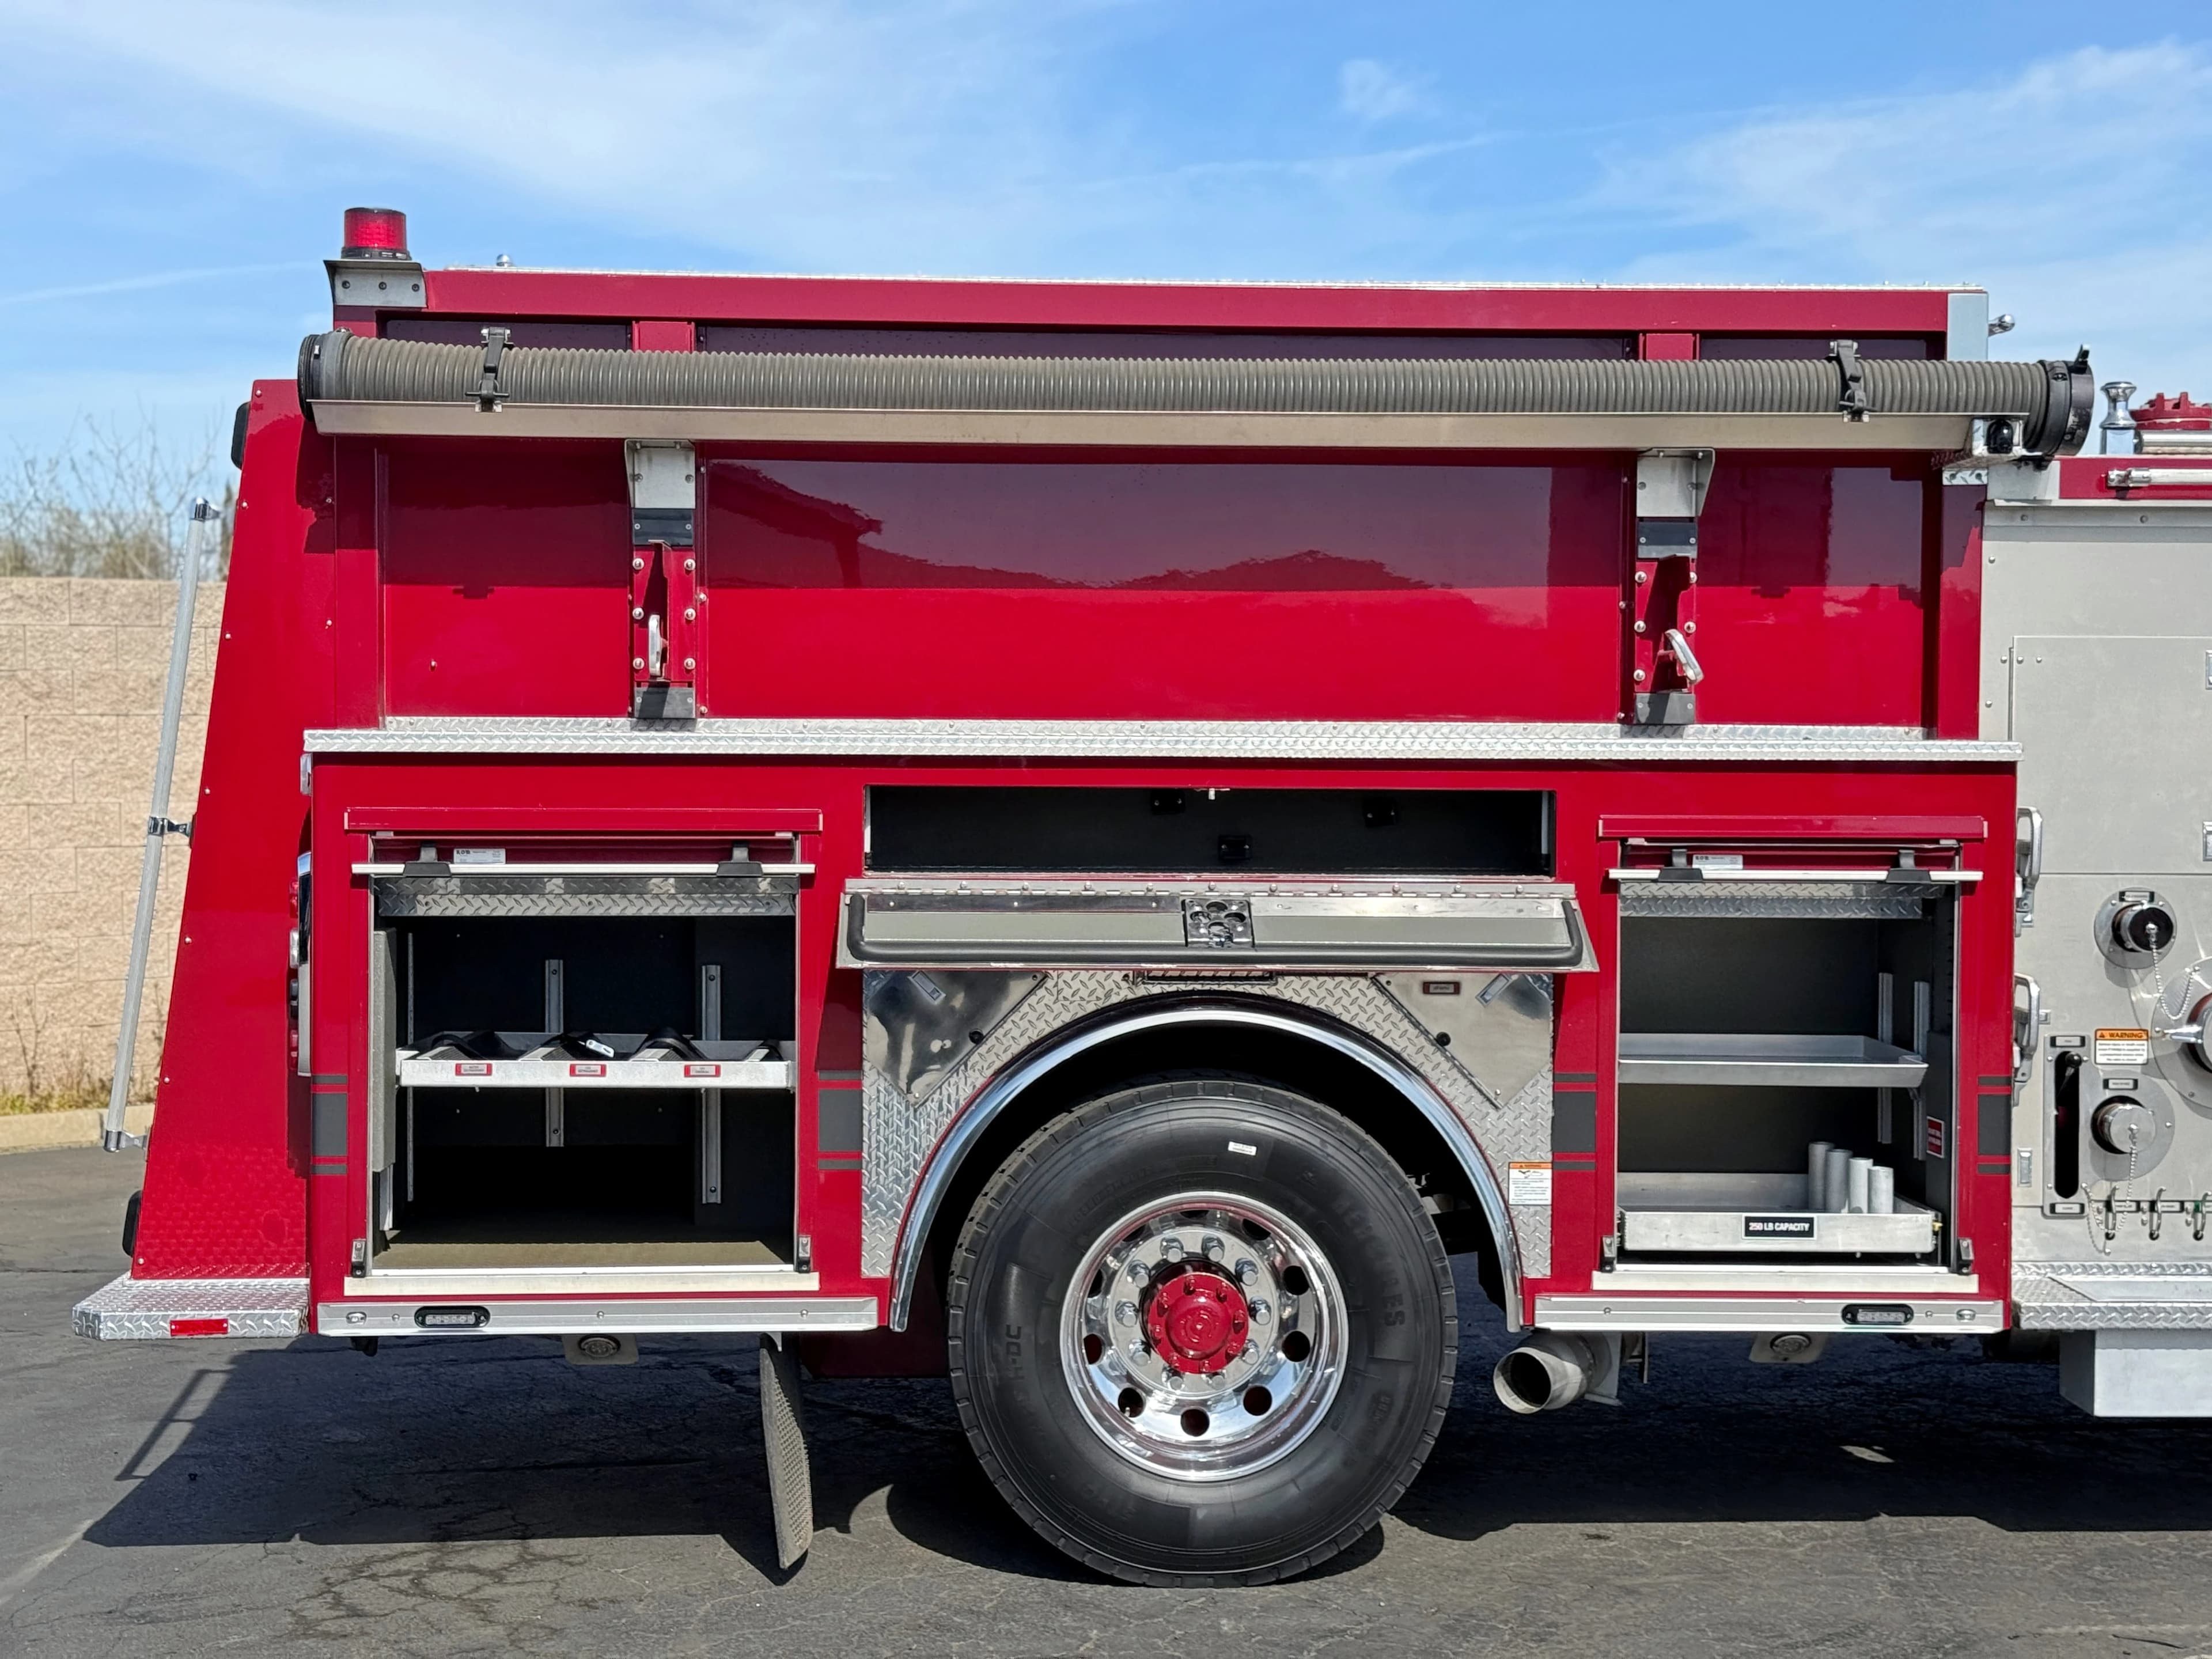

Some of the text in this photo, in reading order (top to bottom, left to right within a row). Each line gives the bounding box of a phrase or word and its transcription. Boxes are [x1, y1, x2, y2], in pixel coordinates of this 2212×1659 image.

[1749, 1222, 1810, 1231] 250 LB CAPACITY
